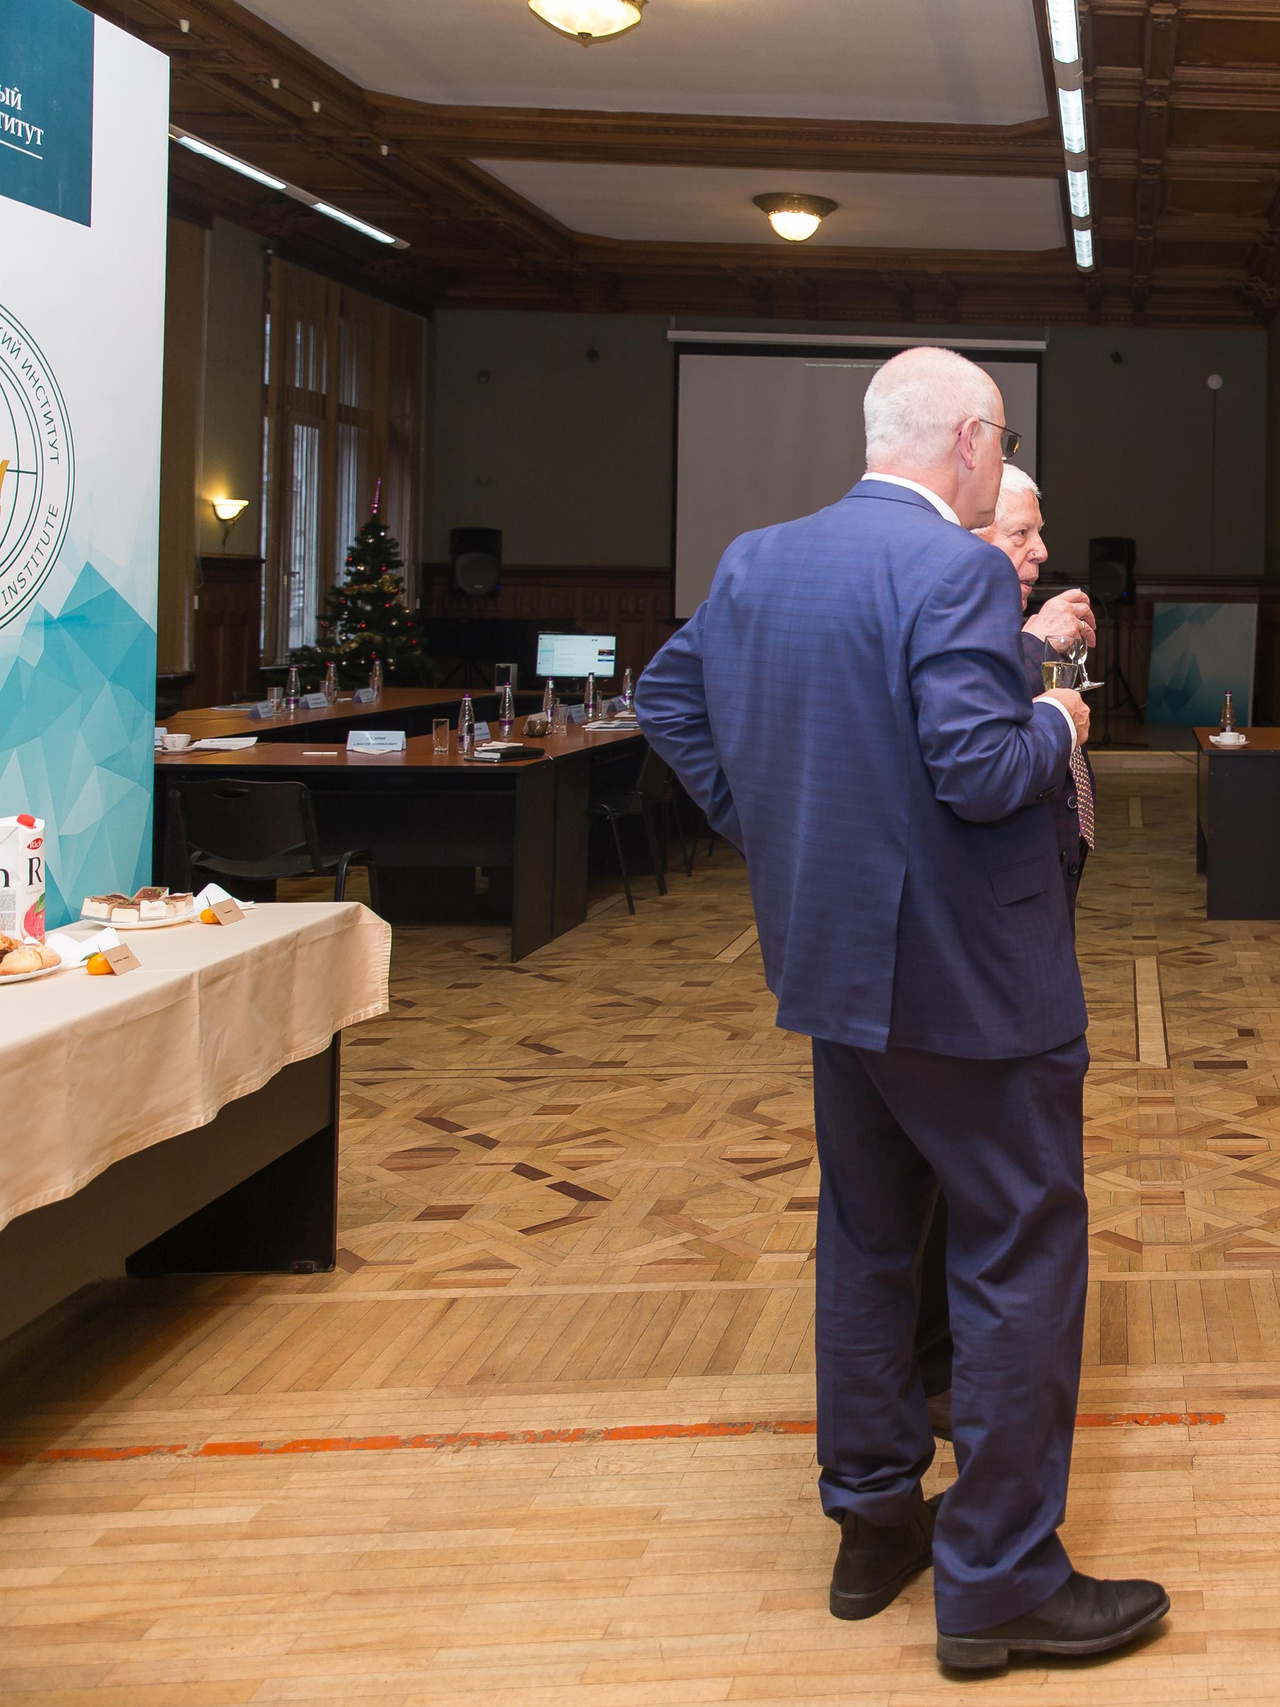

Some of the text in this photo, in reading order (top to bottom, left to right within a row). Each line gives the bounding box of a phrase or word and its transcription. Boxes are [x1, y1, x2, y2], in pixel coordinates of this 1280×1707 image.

[0, 327, 22, 360] ИЙ
[21, 358, 60, 465] ИНСТИТУТ
[1, 503, 59, 606] INSTITUTE
